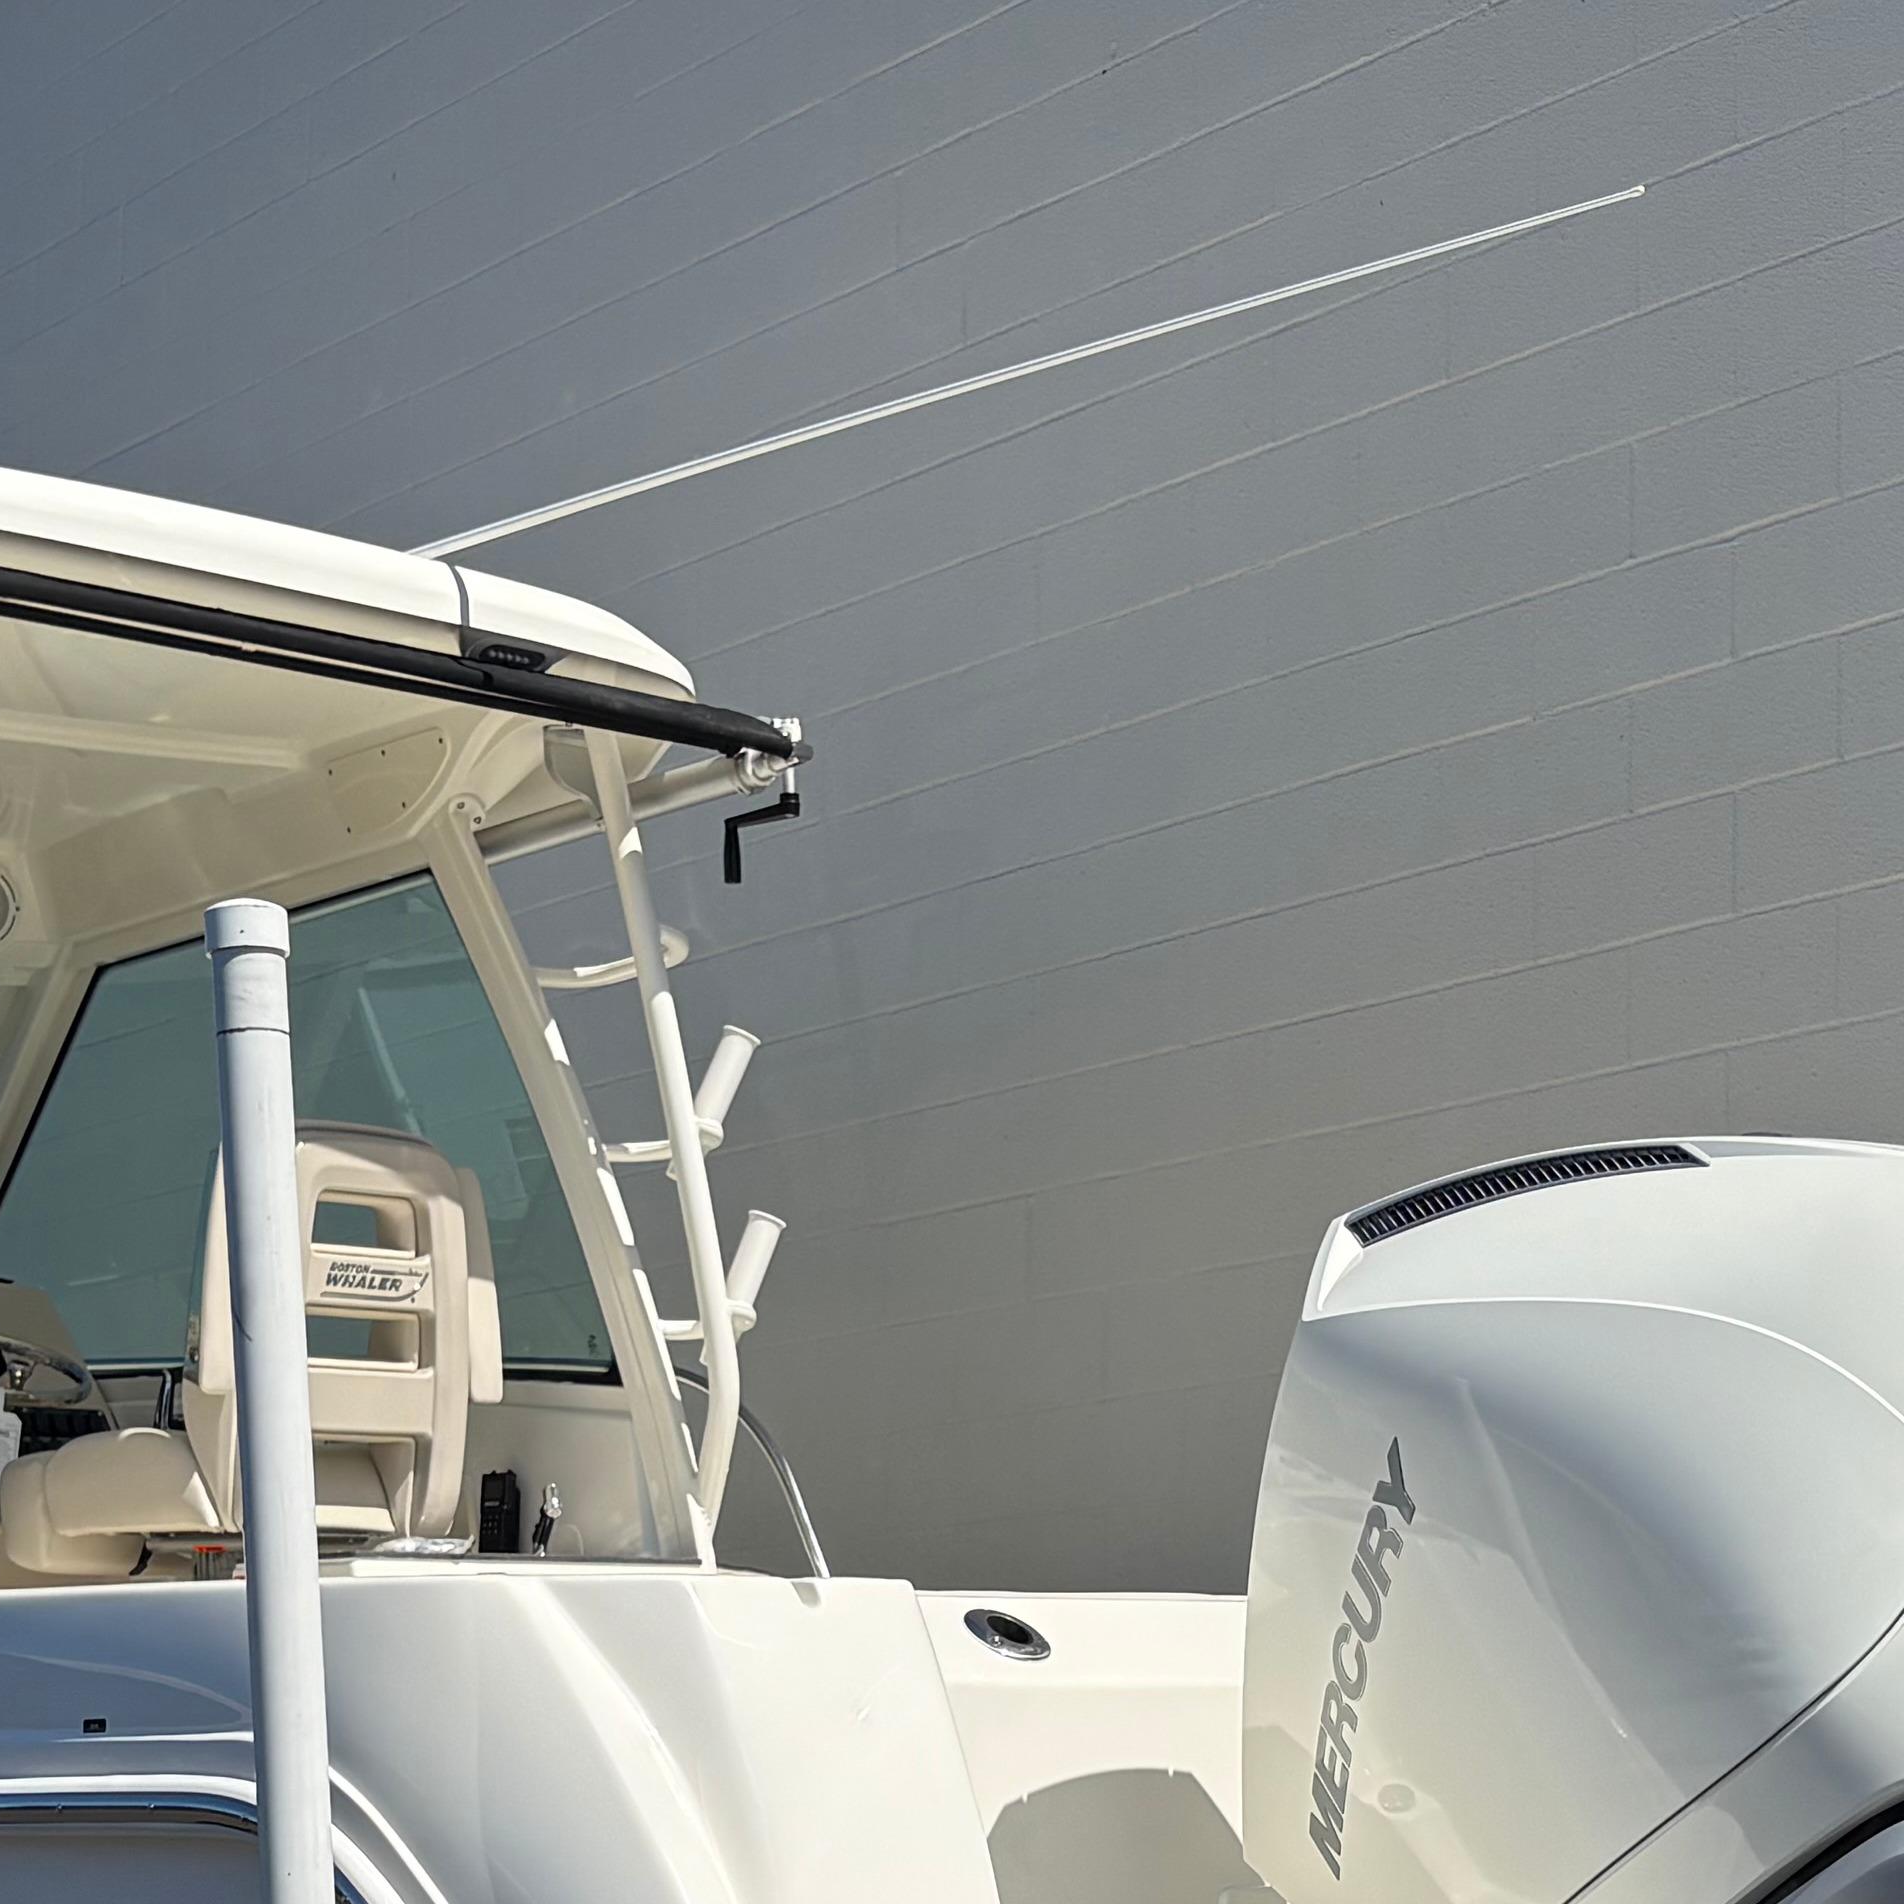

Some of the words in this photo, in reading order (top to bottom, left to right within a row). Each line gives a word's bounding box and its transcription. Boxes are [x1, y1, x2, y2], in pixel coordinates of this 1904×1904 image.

[329, 1261, 371, 1274] BOSTON
[325, 1273, 403, 1292] WHALER
[1308, 1436, 1415, 1881] MERCURY
